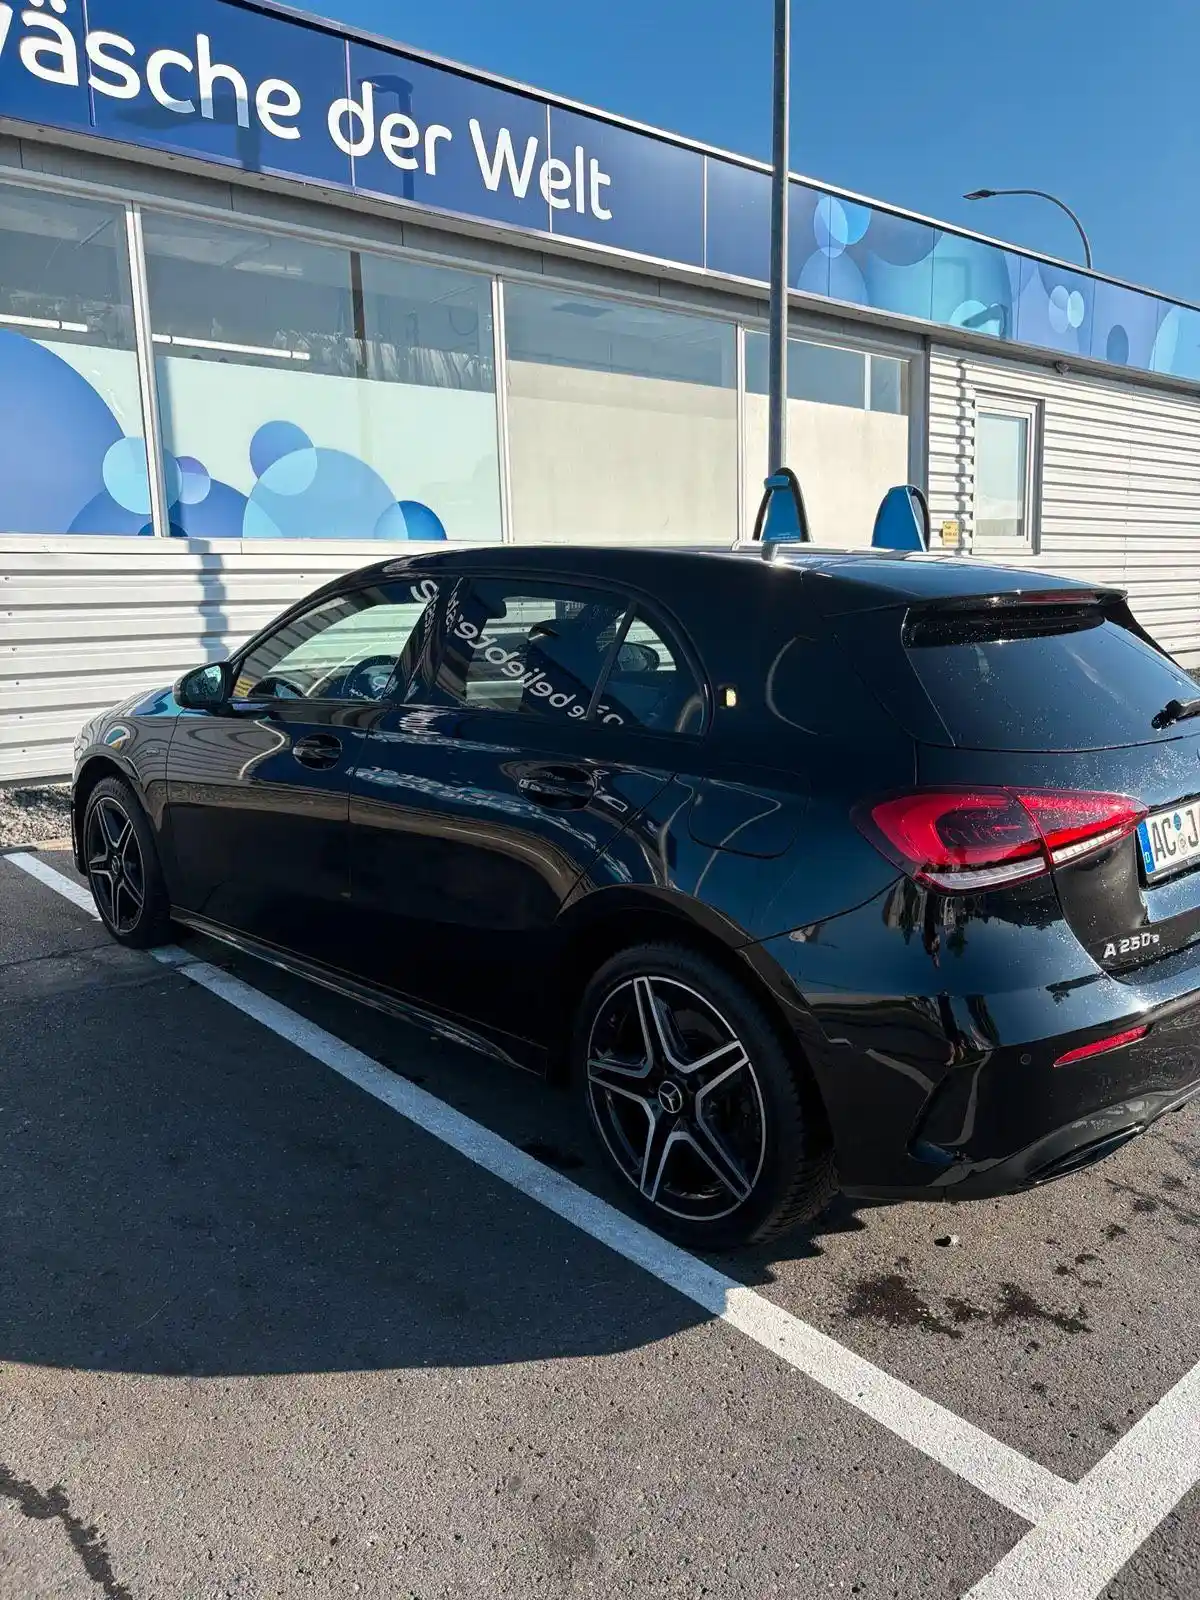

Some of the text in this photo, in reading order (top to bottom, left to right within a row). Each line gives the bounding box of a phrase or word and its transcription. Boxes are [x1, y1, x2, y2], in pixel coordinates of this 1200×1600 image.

[0, 0, 613, 220] äsche der Welt
[1151, 817, 1176, 862] AC
[1103, 943, 1116, 959] A
